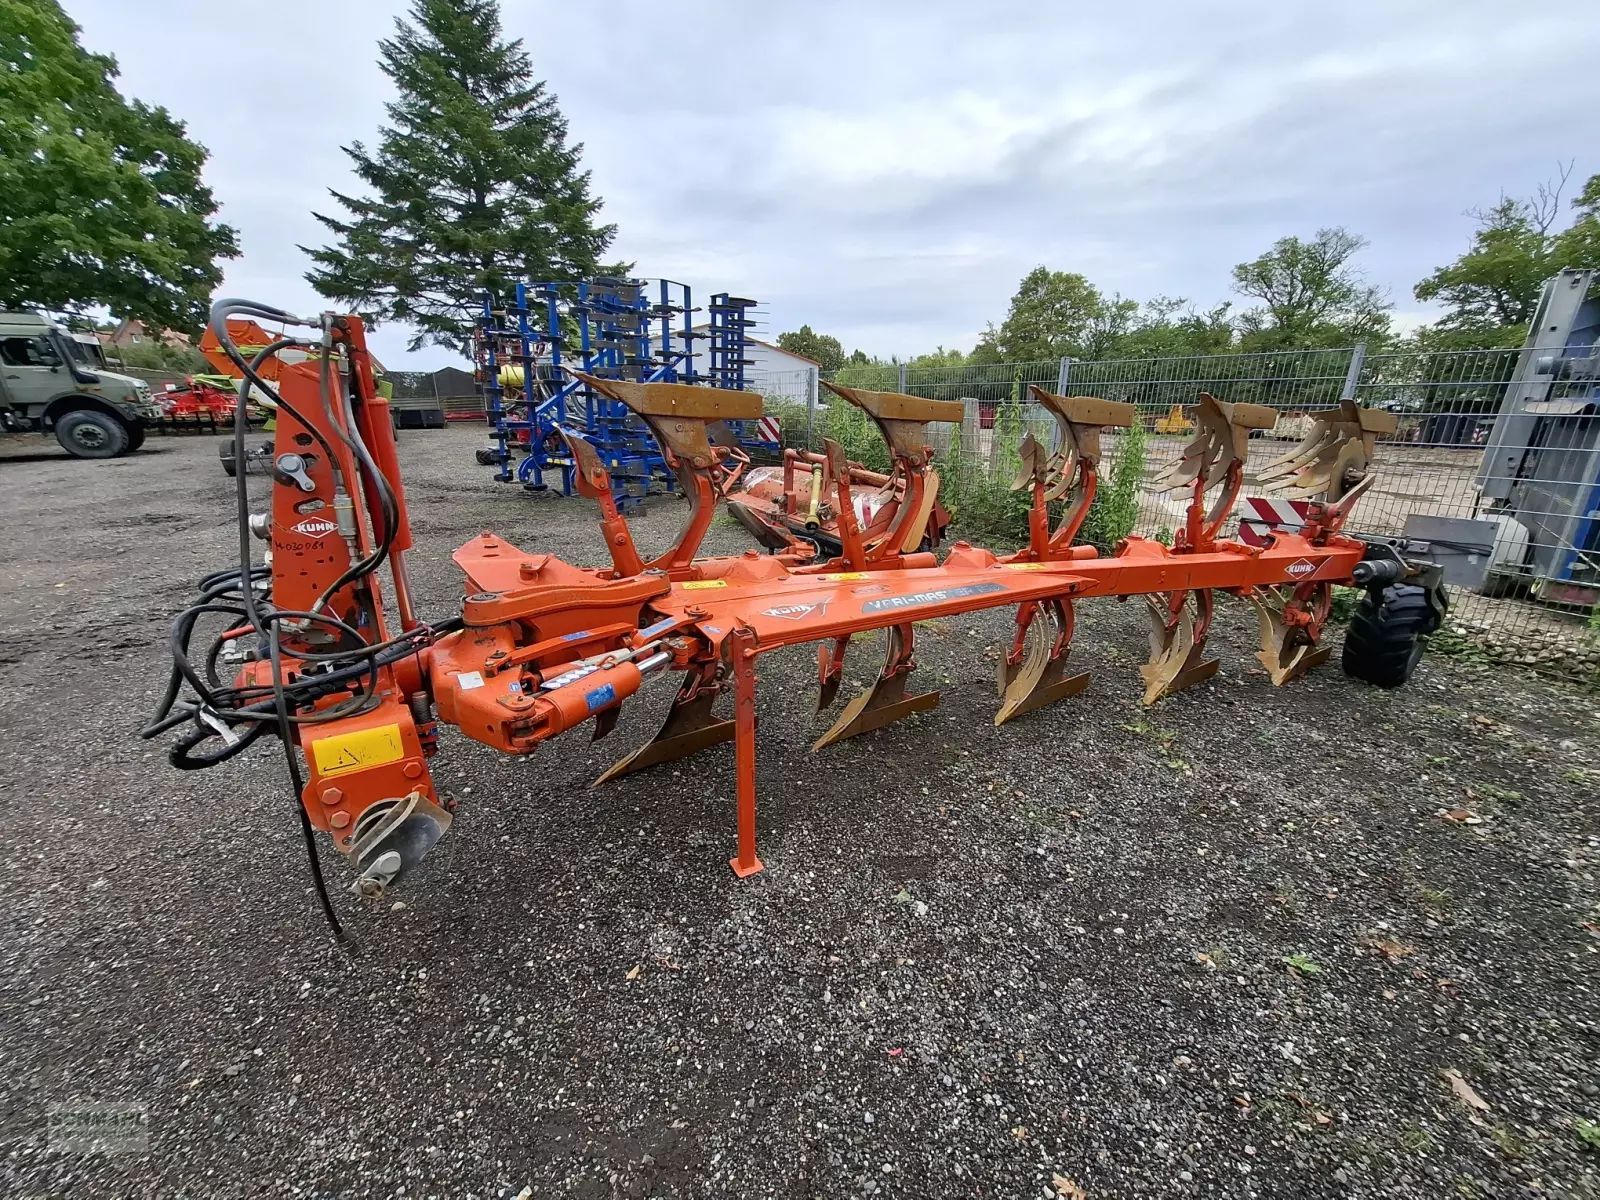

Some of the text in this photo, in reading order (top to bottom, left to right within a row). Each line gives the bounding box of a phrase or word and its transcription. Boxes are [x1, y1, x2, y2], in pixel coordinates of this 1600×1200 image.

[297, 523, 334, 532] KUHN
[1288, 564, 1312, 573] KUHN
[770, 604, 811, 616] KUHN
